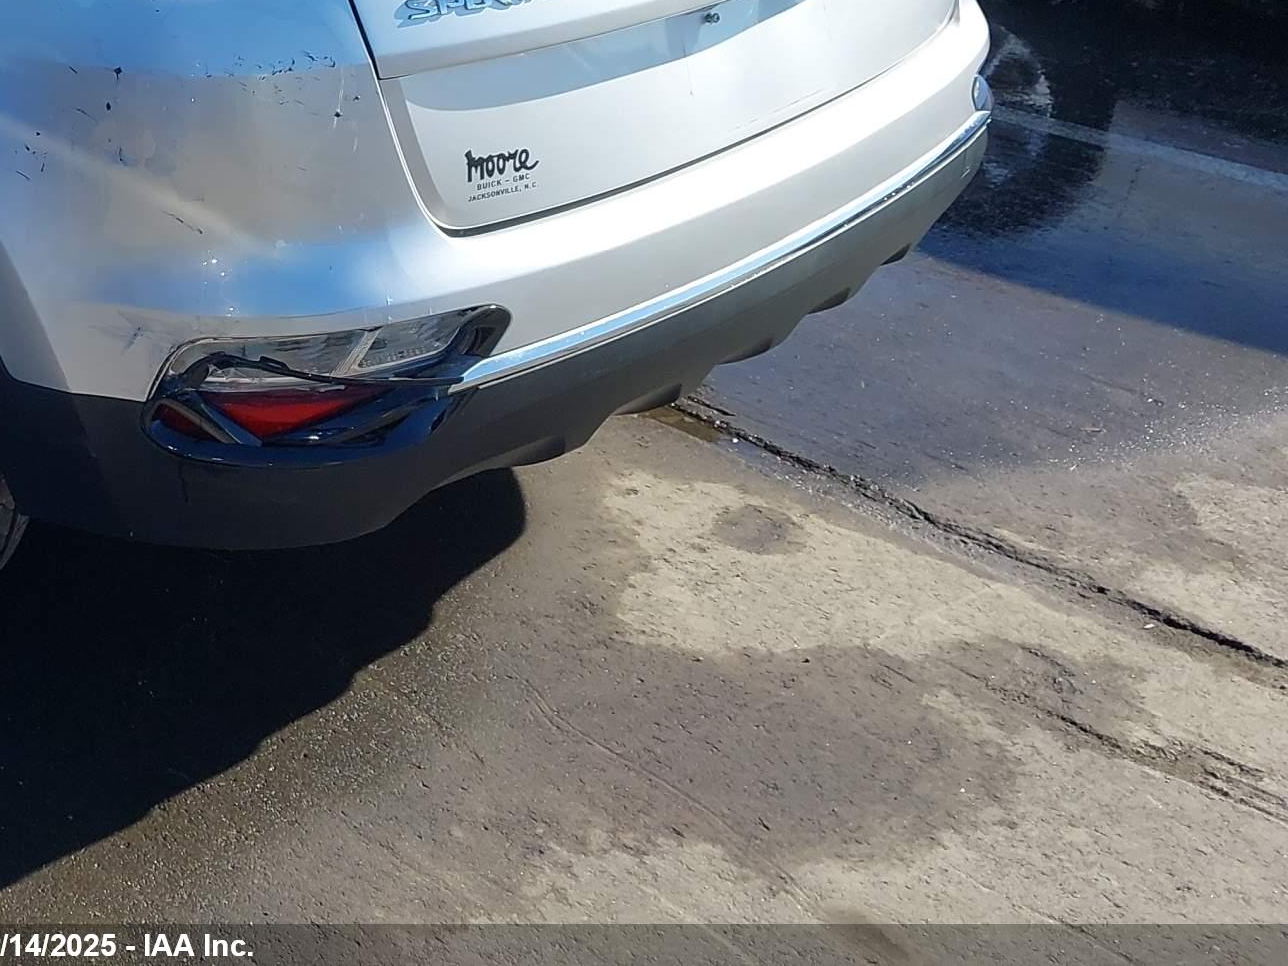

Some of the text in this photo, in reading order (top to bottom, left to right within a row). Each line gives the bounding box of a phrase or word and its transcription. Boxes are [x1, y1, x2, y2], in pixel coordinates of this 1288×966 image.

[476, 178, 502, 191] BUICK
[512, 172, 530, 183] GMC
[467, 185, 522, 203] JACKSONVILLE,
